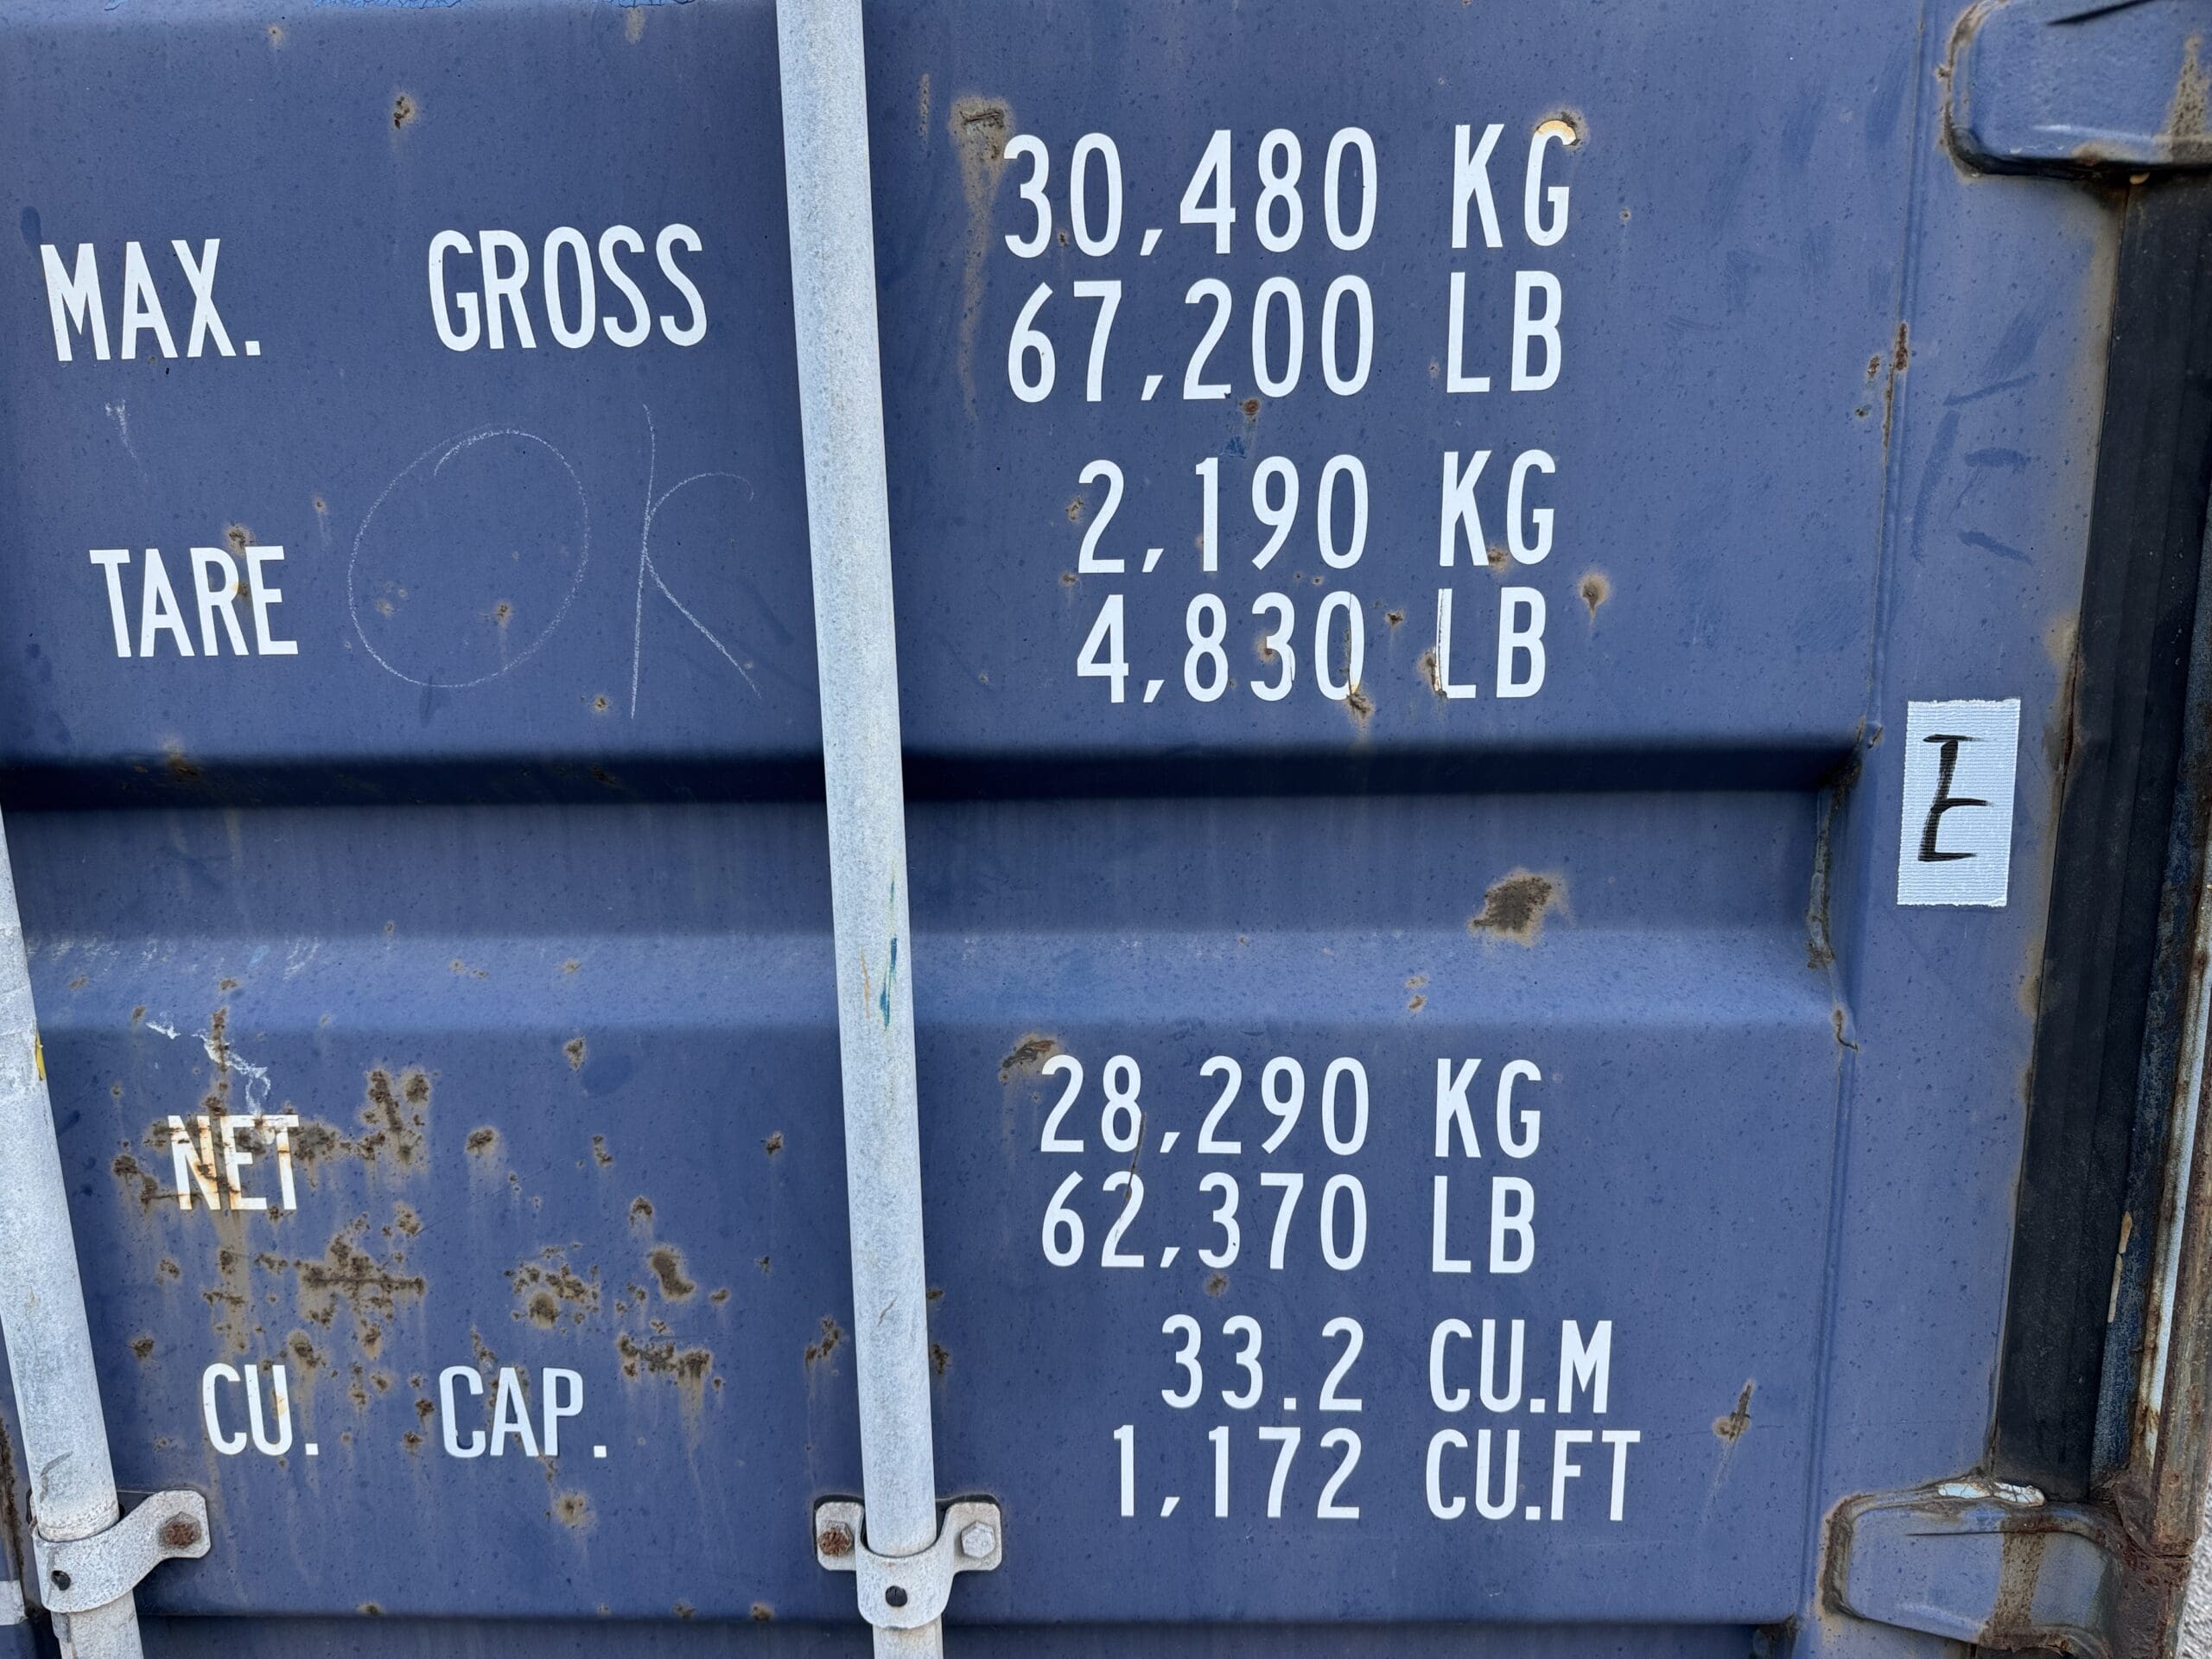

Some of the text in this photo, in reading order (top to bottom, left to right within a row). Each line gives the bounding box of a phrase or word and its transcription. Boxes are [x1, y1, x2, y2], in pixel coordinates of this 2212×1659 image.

[1003, 119, 1578, 261] 30,480 KG
[39, 223, 708, 363] MAX. GROSS
[1007, 270, 1562, 404] 67,200 LB
[348, 404, 762, 719] OK
[1077, 449, 1556, 575] 2,190 KG
[89, 545, 299, 658] TARE
[1077, 586, 1547, 706] 4,830 LB
[167, 1113, 300, 1211] NET
[1040, 1054, 1543, 1160] 28,290 KG
[1042, 1171, 1535, 1274] 62,370 LB
[202, 1363, 608, 1459] CU. CAP.
[1161, 1313, 1613, 1414] 33.2 CU.M
[1113, 1424, 1643, 1522] 1,172 CU.FT
